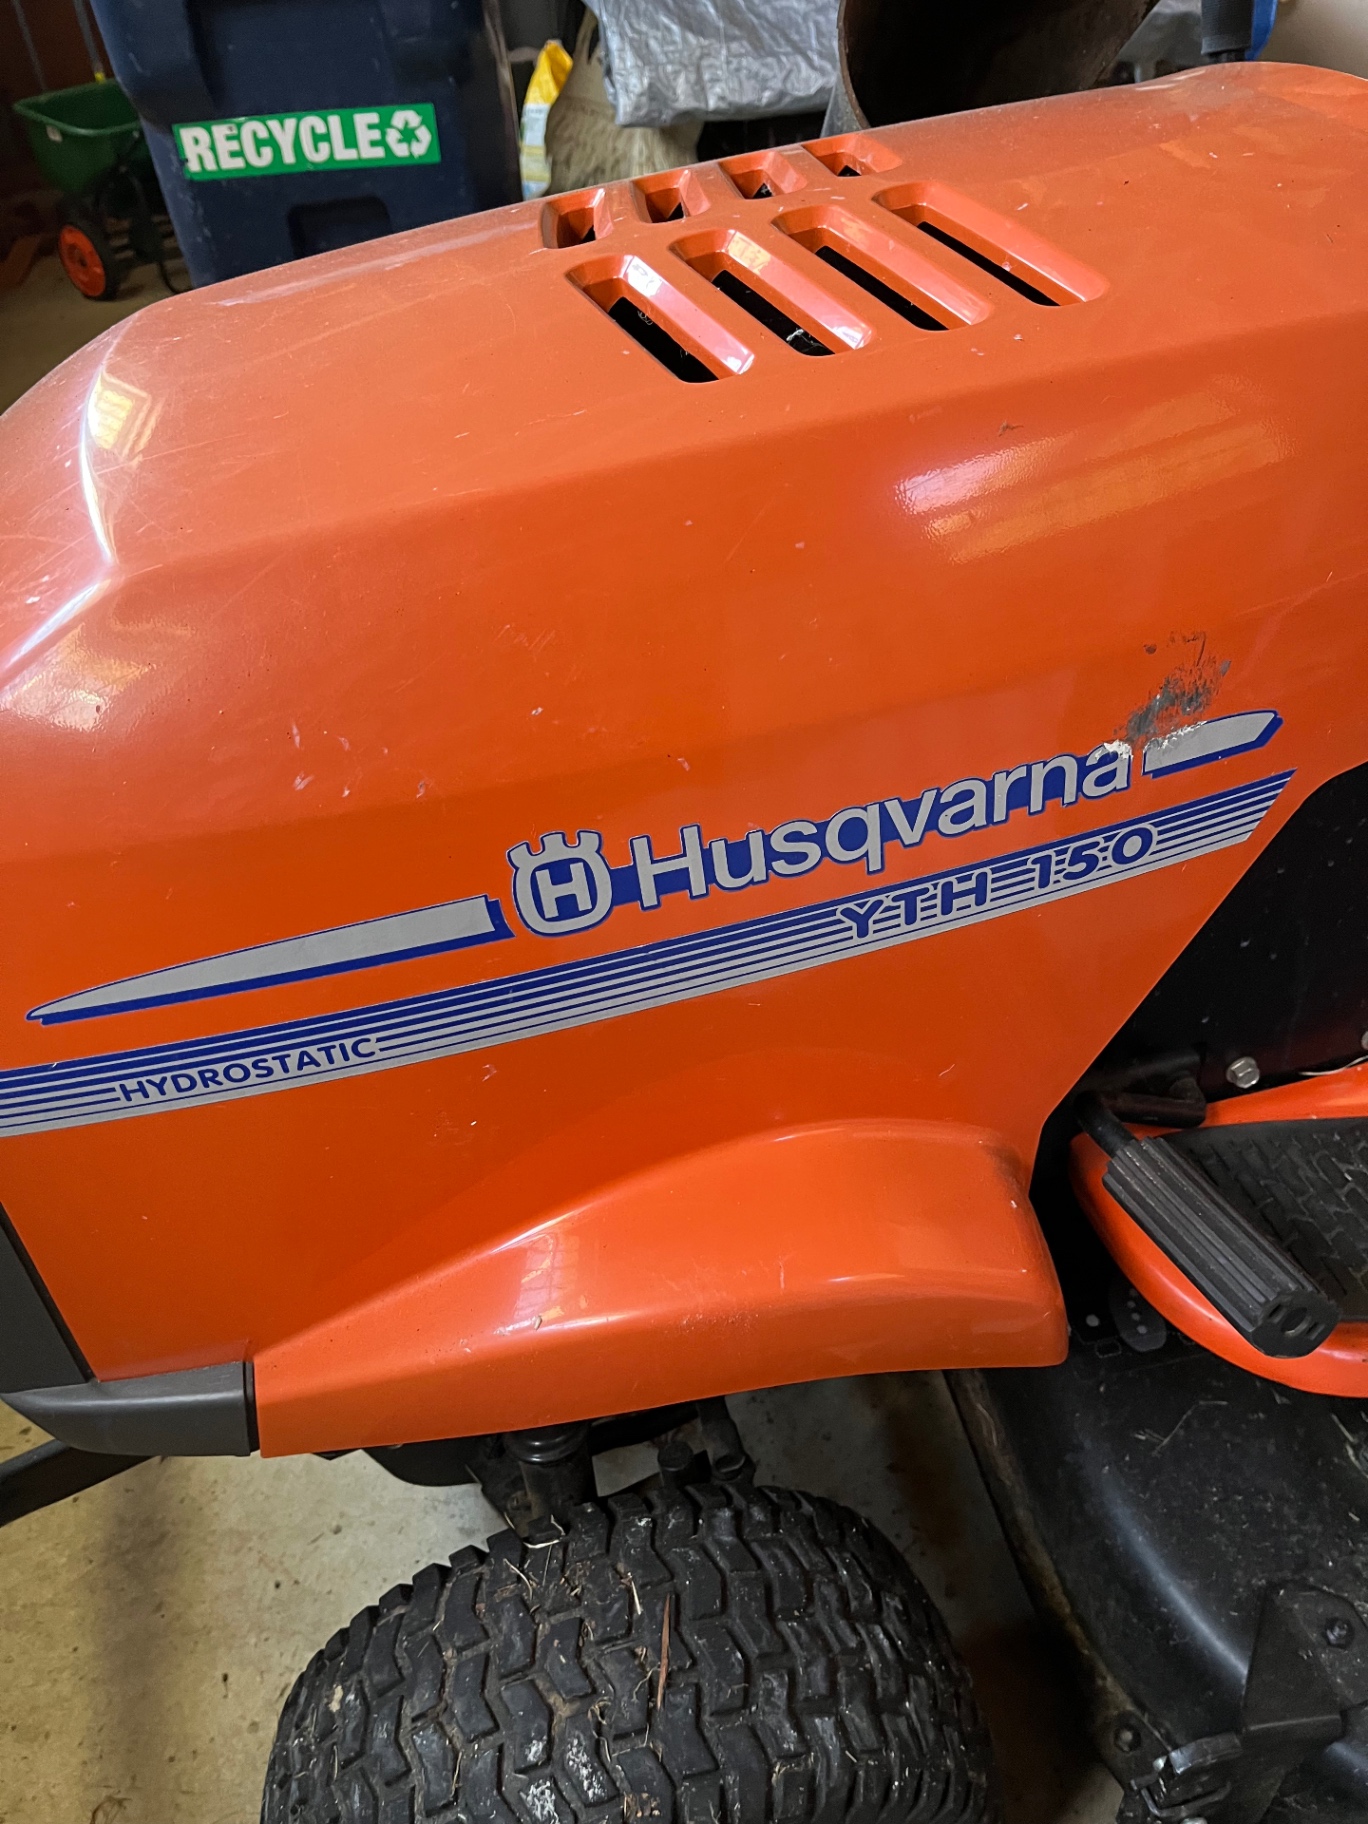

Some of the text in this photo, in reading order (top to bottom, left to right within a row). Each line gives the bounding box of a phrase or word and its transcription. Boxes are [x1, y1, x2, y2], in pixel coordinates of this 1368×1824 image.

[179, 112, 385, 173] RECYCLE
[630, 742, 1131, 908] Husqvarna
[839, 826, 1156, 939] YTH 150
[119, 1037, 377, 1102] HYDROSTATIC
